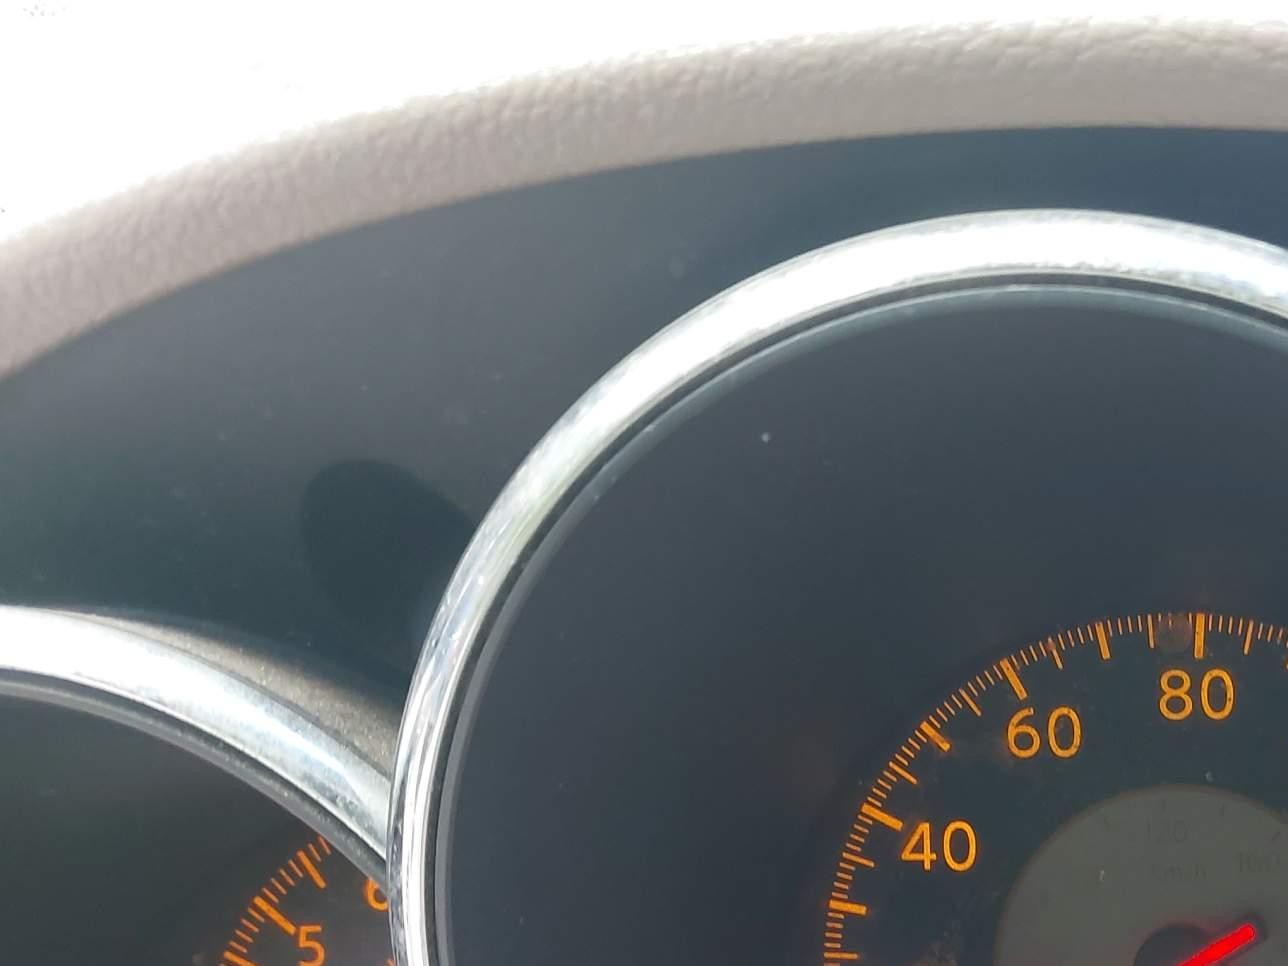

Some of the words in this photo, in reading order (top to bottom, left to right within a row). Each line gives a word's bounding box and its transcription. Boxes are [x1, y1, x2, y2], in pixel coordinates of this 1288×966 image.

[1158, 667, 1236, 721] 80
[1006, 705, 1083, 759] 60
[900, 821, 978, 873] 40
